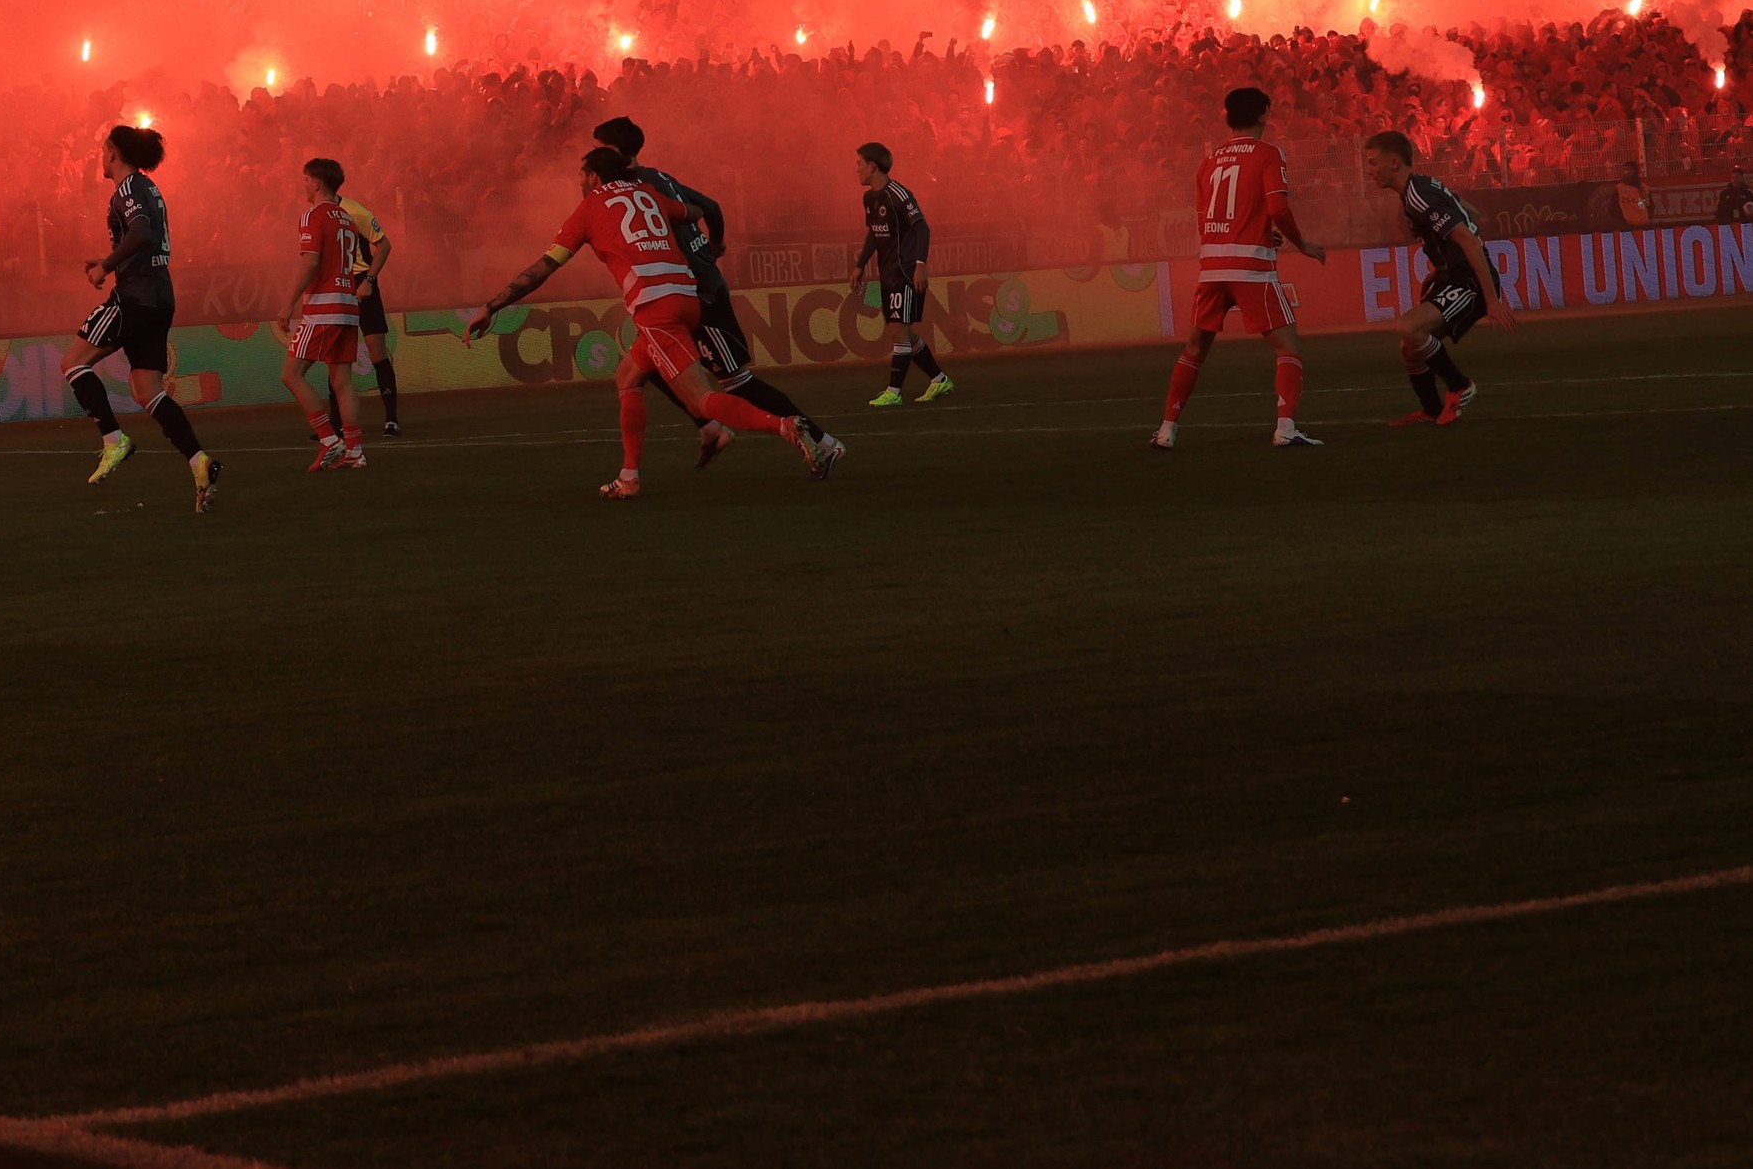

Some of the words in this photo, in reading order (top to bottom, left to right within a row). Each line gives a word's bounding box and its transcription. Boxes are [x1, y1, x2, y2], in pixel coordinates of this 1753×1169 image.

[1206, 164, 1240, 220] 11
[604, 190, 668, 244] 28
[1204, 222, 1230, 235] JEONG
[336, 228, 355, 275] 13
[635, 240, 671, 252] TRIMMEL
[1360, 236, 1565, 323] EIRN
[1581, 222, 1753, 305] UNION
[889, 292, 902, 310] 20
